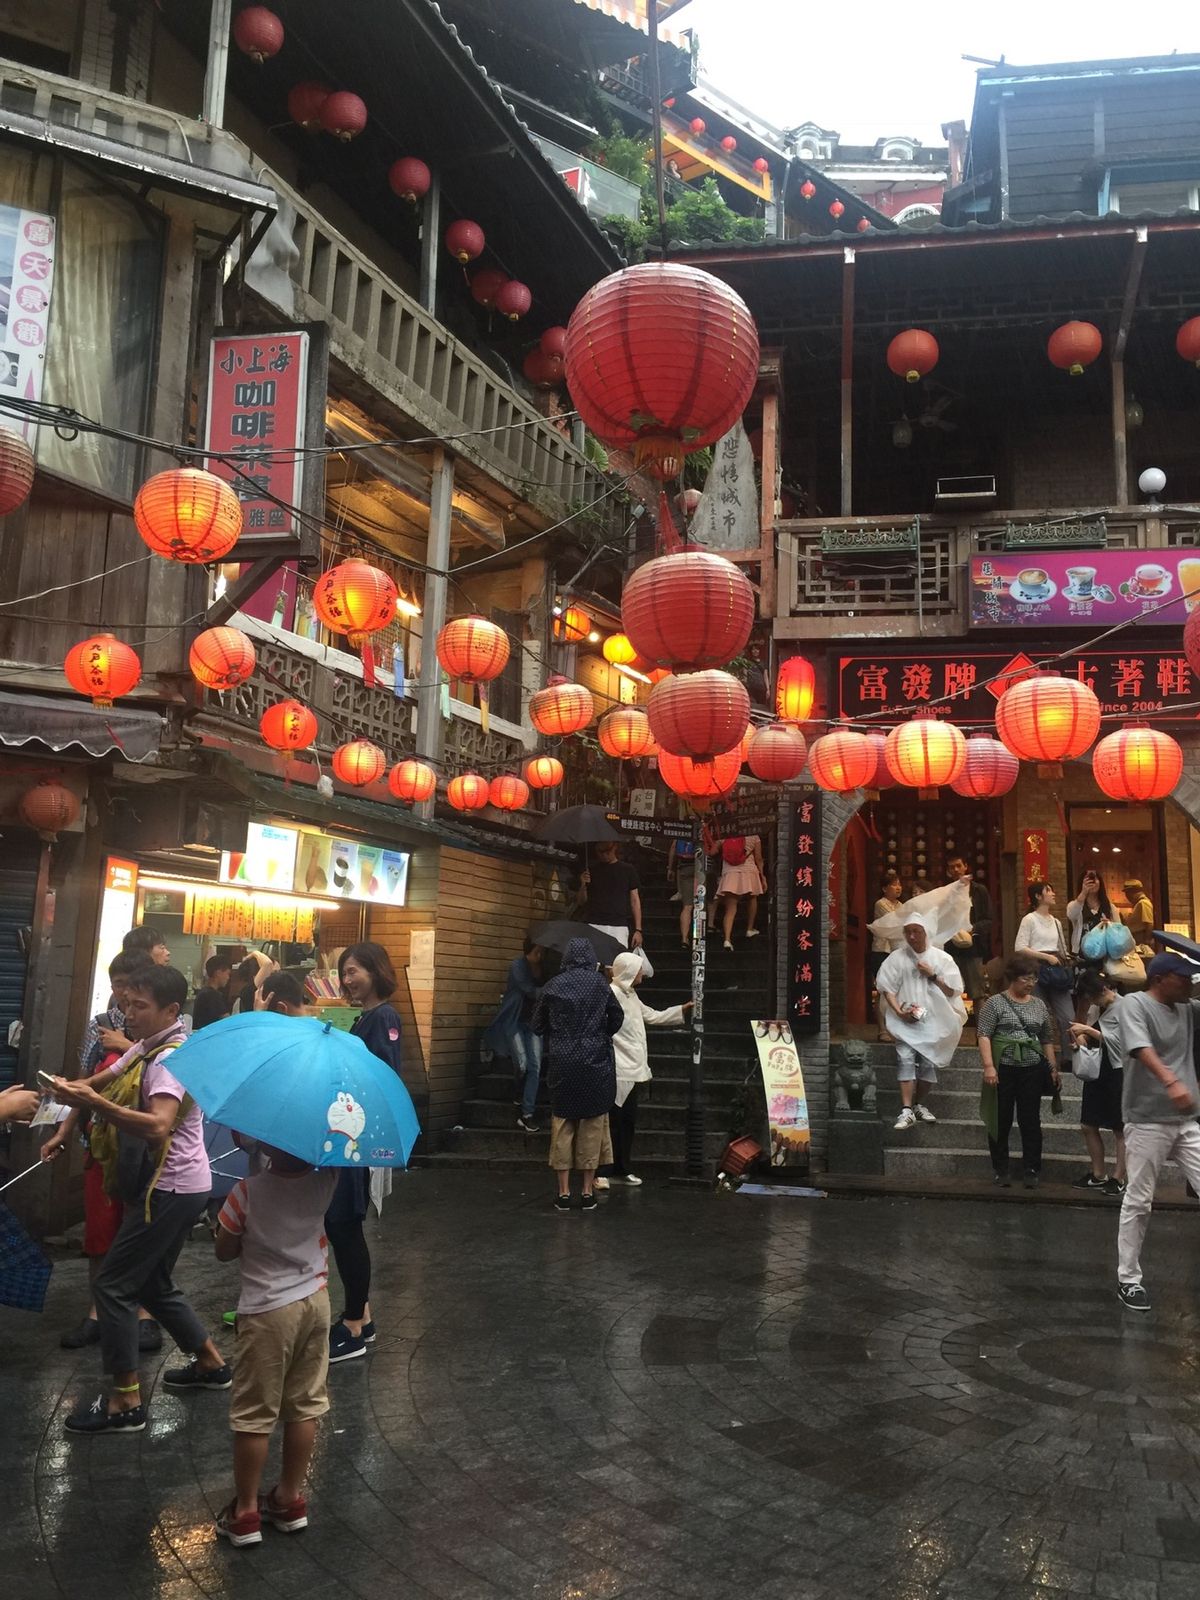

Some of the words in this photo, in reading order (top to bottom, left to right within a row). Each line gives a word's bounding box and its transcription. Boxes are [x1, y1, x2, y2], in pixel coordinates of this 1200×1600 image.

[220, 344, 293, 374] 小上海
[720, 436, 742, 537] 悲情城市
[241, 509, 286, 528] 雅座
[857, 662, 976, 700] 富發牌
[915, 706, 952, 714] Shoes
[1099, 702, 1128, 712] ince
[1132, 701, 1163, 712] 2004
[795, 801, 815, 1016] 富發繽紛客滿堂
